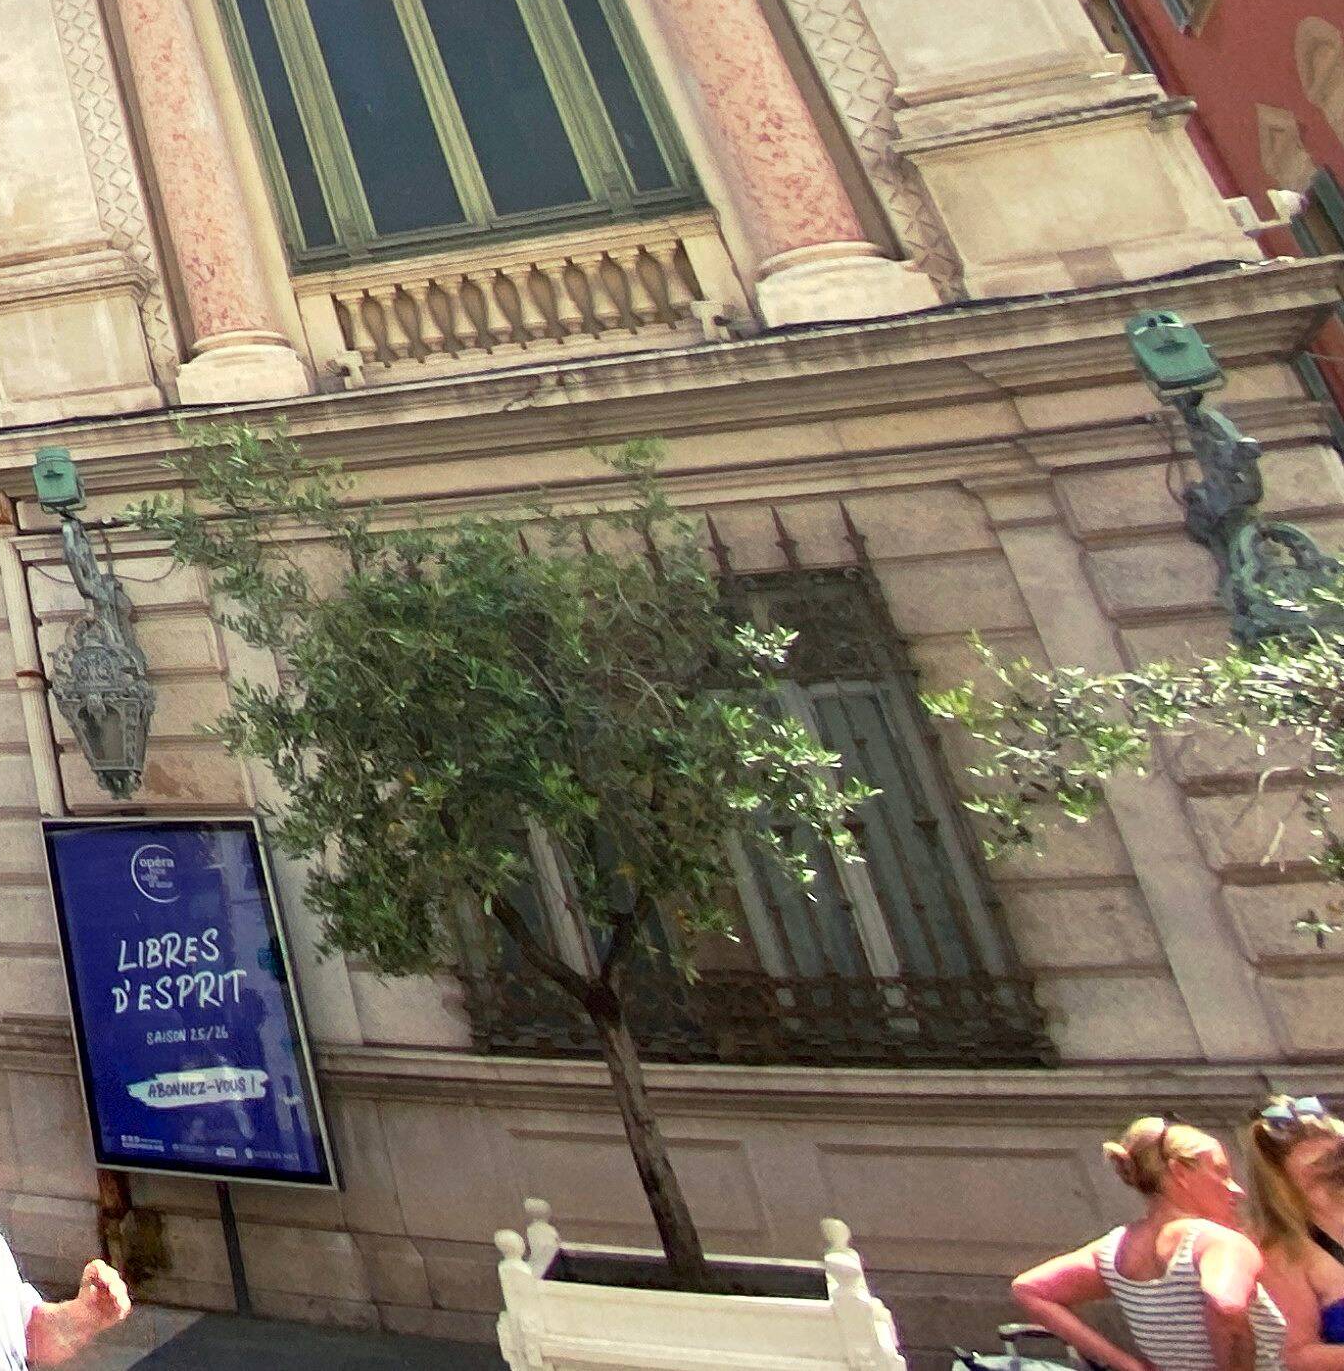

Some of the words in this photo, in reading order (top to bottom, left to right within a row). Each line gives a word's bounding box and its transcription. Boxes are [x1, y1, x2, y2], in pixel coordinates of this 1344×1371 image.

[117, 928, 219, 972] LIBRES
[111, 968, 248, 1014] D'ESPRIT
[146, 1029, 186, 1045] SAISON
